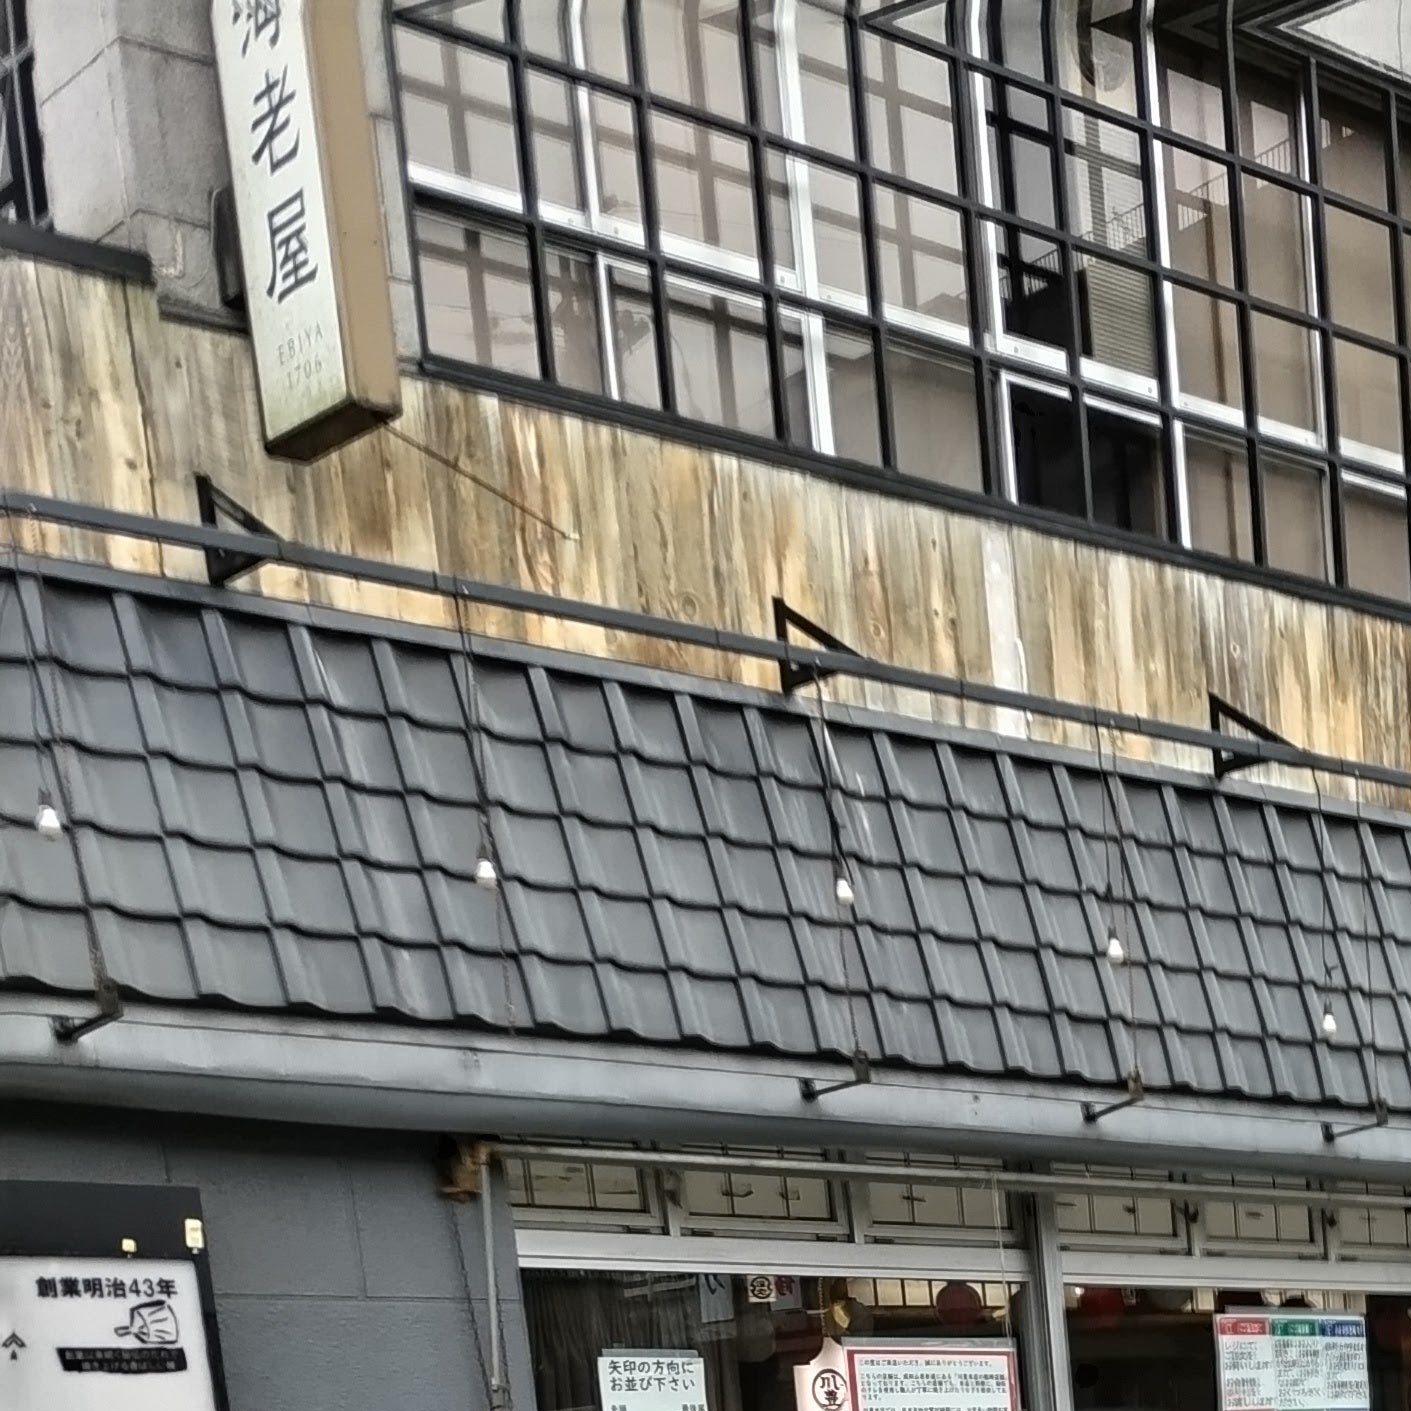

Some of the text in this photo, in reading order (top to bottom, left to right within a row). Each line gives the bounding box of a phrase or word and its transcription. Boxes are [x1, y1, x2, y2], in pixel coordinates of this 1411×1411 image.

[277, 320, 323, 366] EBIYA
[35, 1276, 178, 1299] 創業明治43年
[608, 1360, 695, 1376] 矢印の方向に
[610, 1376, 696, 1392] お並び下さい
